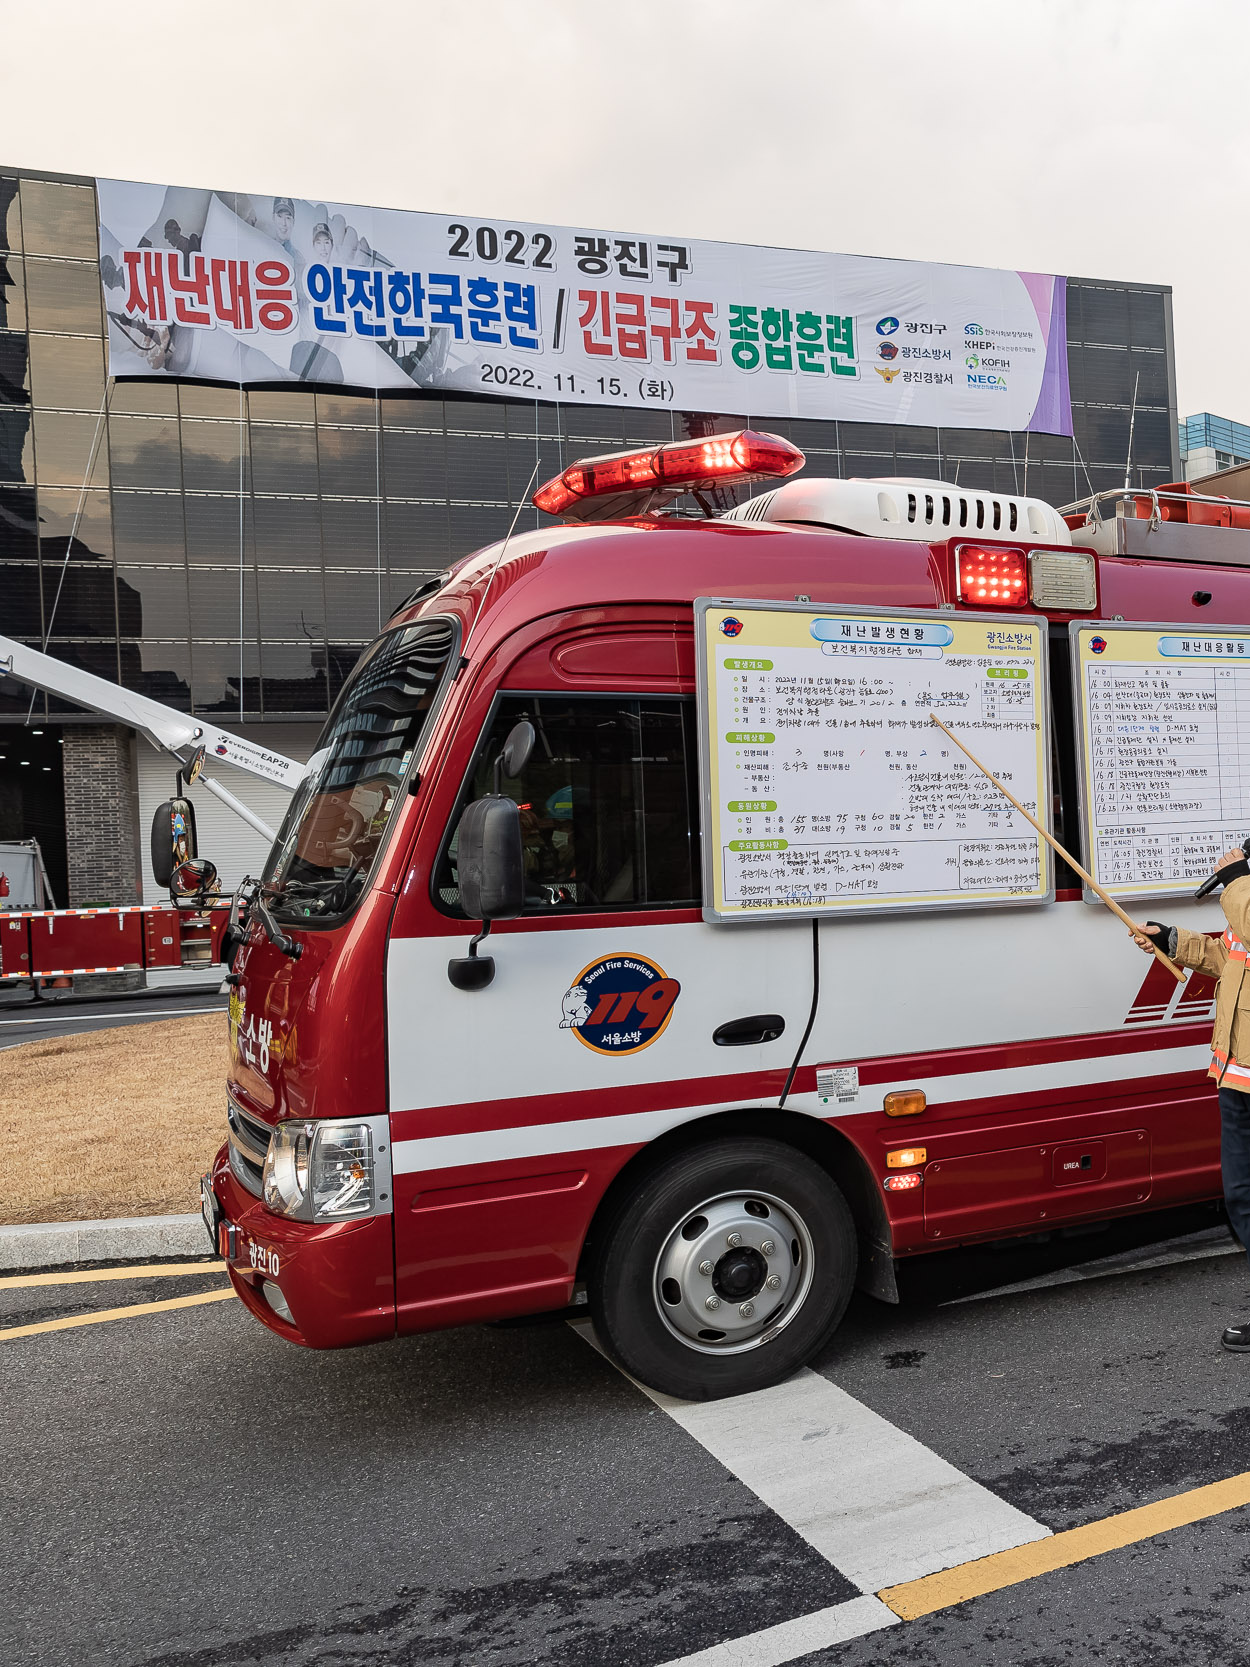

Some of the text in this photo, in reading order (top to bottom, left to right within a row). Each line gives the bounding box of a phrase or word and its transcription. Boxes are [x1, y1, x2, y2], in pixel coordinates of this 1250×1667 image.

[447, 224, 689, 283] 2022 광진구
[124, 250, 295, 331] 재난대응
[307, 263, 539, 350] 안전한국훈련
[578, 289, 718, 362] 긴급구조
[728, 304, 857, 377] 종합훈련
[904, 322, 948, 335] 광진구
[901, 346, 952, 361] 광진소방서
[981, 357, 1010, 368] KOFIH
[481, 364, 675, 401] 2022. 11. 15. (화)
[902, 370, 953, 385] 광진경찰서
[967, 374, 1007, 385] NECA
[841, 624, 925, 640] 재난발생현황
[986, 631, 1033, 645] 광진소방서
[1182, 640, 1245, 654] 재난대응활동
[733, 661, 764, 669] 발생개요
[995, 669, 1020, 677] 브리핑
[742, 696, 767, 704] 건물구조
[735, 734, 766, 742] 피해상황
[260, 752, 290, 770] EAP28
[743, 763, 769, 771] 재산피해
[737, 802, 767, 811] 동원상황
[871, 812, 885, 821] 60
[889, 813, 901, 821] 경찰
[854, 824, 867, 832] 구청
[889, 823, 901, 831] 경찰
[1104, 827, 1146, 836] 유관기관 활동사항
[738, 841, 780, 850] 주요활동사항
[584, 959, 655, 984] Seoul Fire Services
[584, 977, 681, 1029] 119
[245, 1013, 274, 1075] 소방
[601, 1030, 642, 1045] 서울소방
[1063, 1161, 1080, 1170] UREA
[249, 1240, 280, 1277] 광진10
